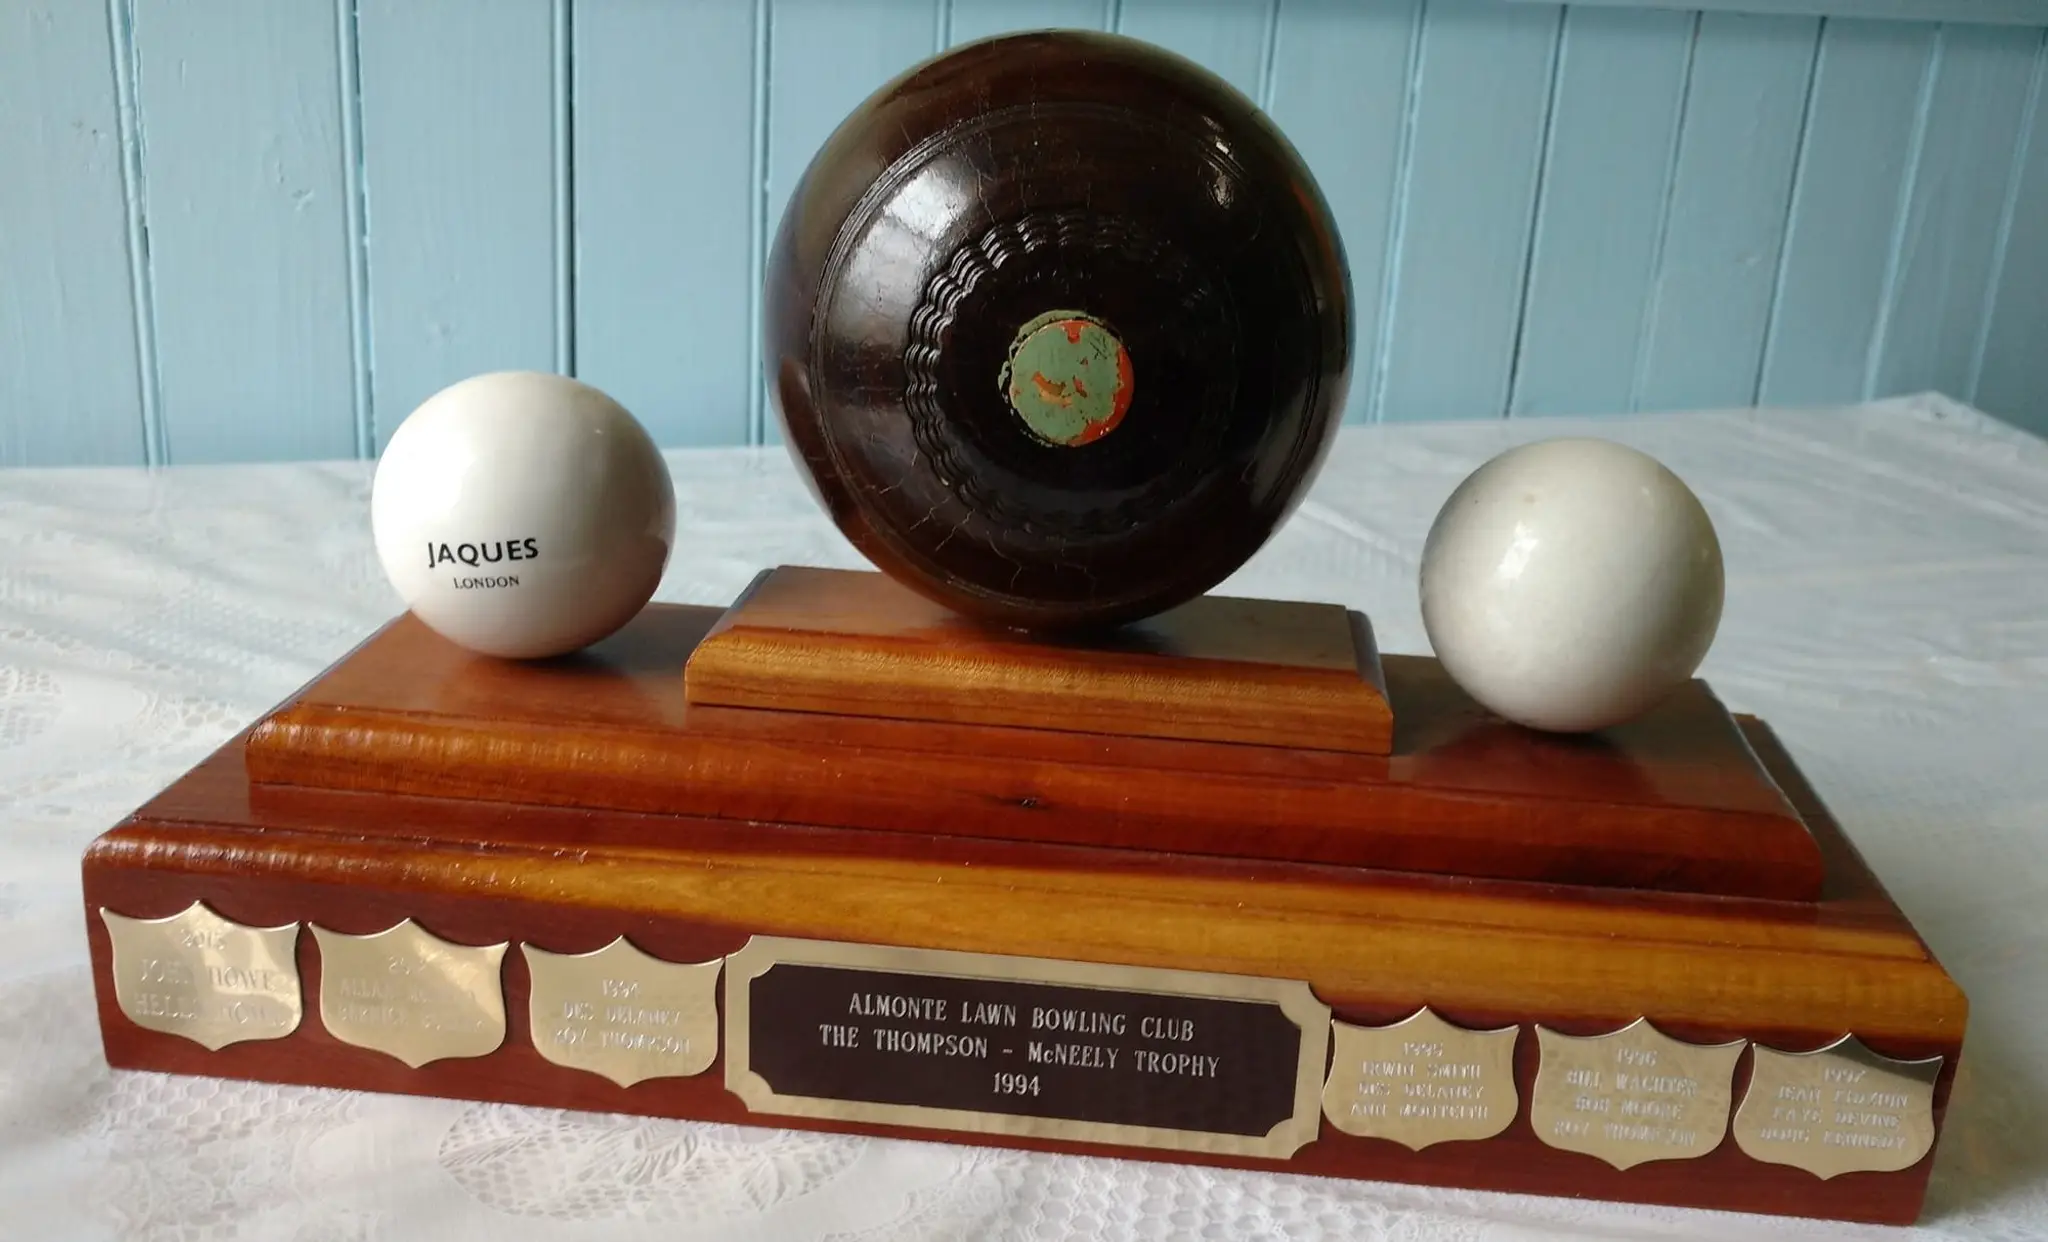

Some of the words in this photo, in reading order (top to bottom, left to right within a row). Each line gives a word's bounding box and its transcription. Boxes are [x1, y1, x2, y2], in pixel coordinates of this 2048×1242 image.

[428, 538, 540, 568] JAQUES
[453, 575, 520, 589] LONDON
[849, 992, 948, 1022] ALMONTE
[961, 1001, 1017, 1027] LAWN
[1032, 1007, 1126, 1036] BOWLING
[1141, 1015, 1195, 1042] CLUB
[819, 1024, 859, 1048] THE
[874, 1028, 988, 1059] THOMPSON
[1028, 1042, 1120, 1070] McNEELY
[1135, 1050, 1221, 1079] TROPHY
[993, 1072, 1041, 1097] 1994
